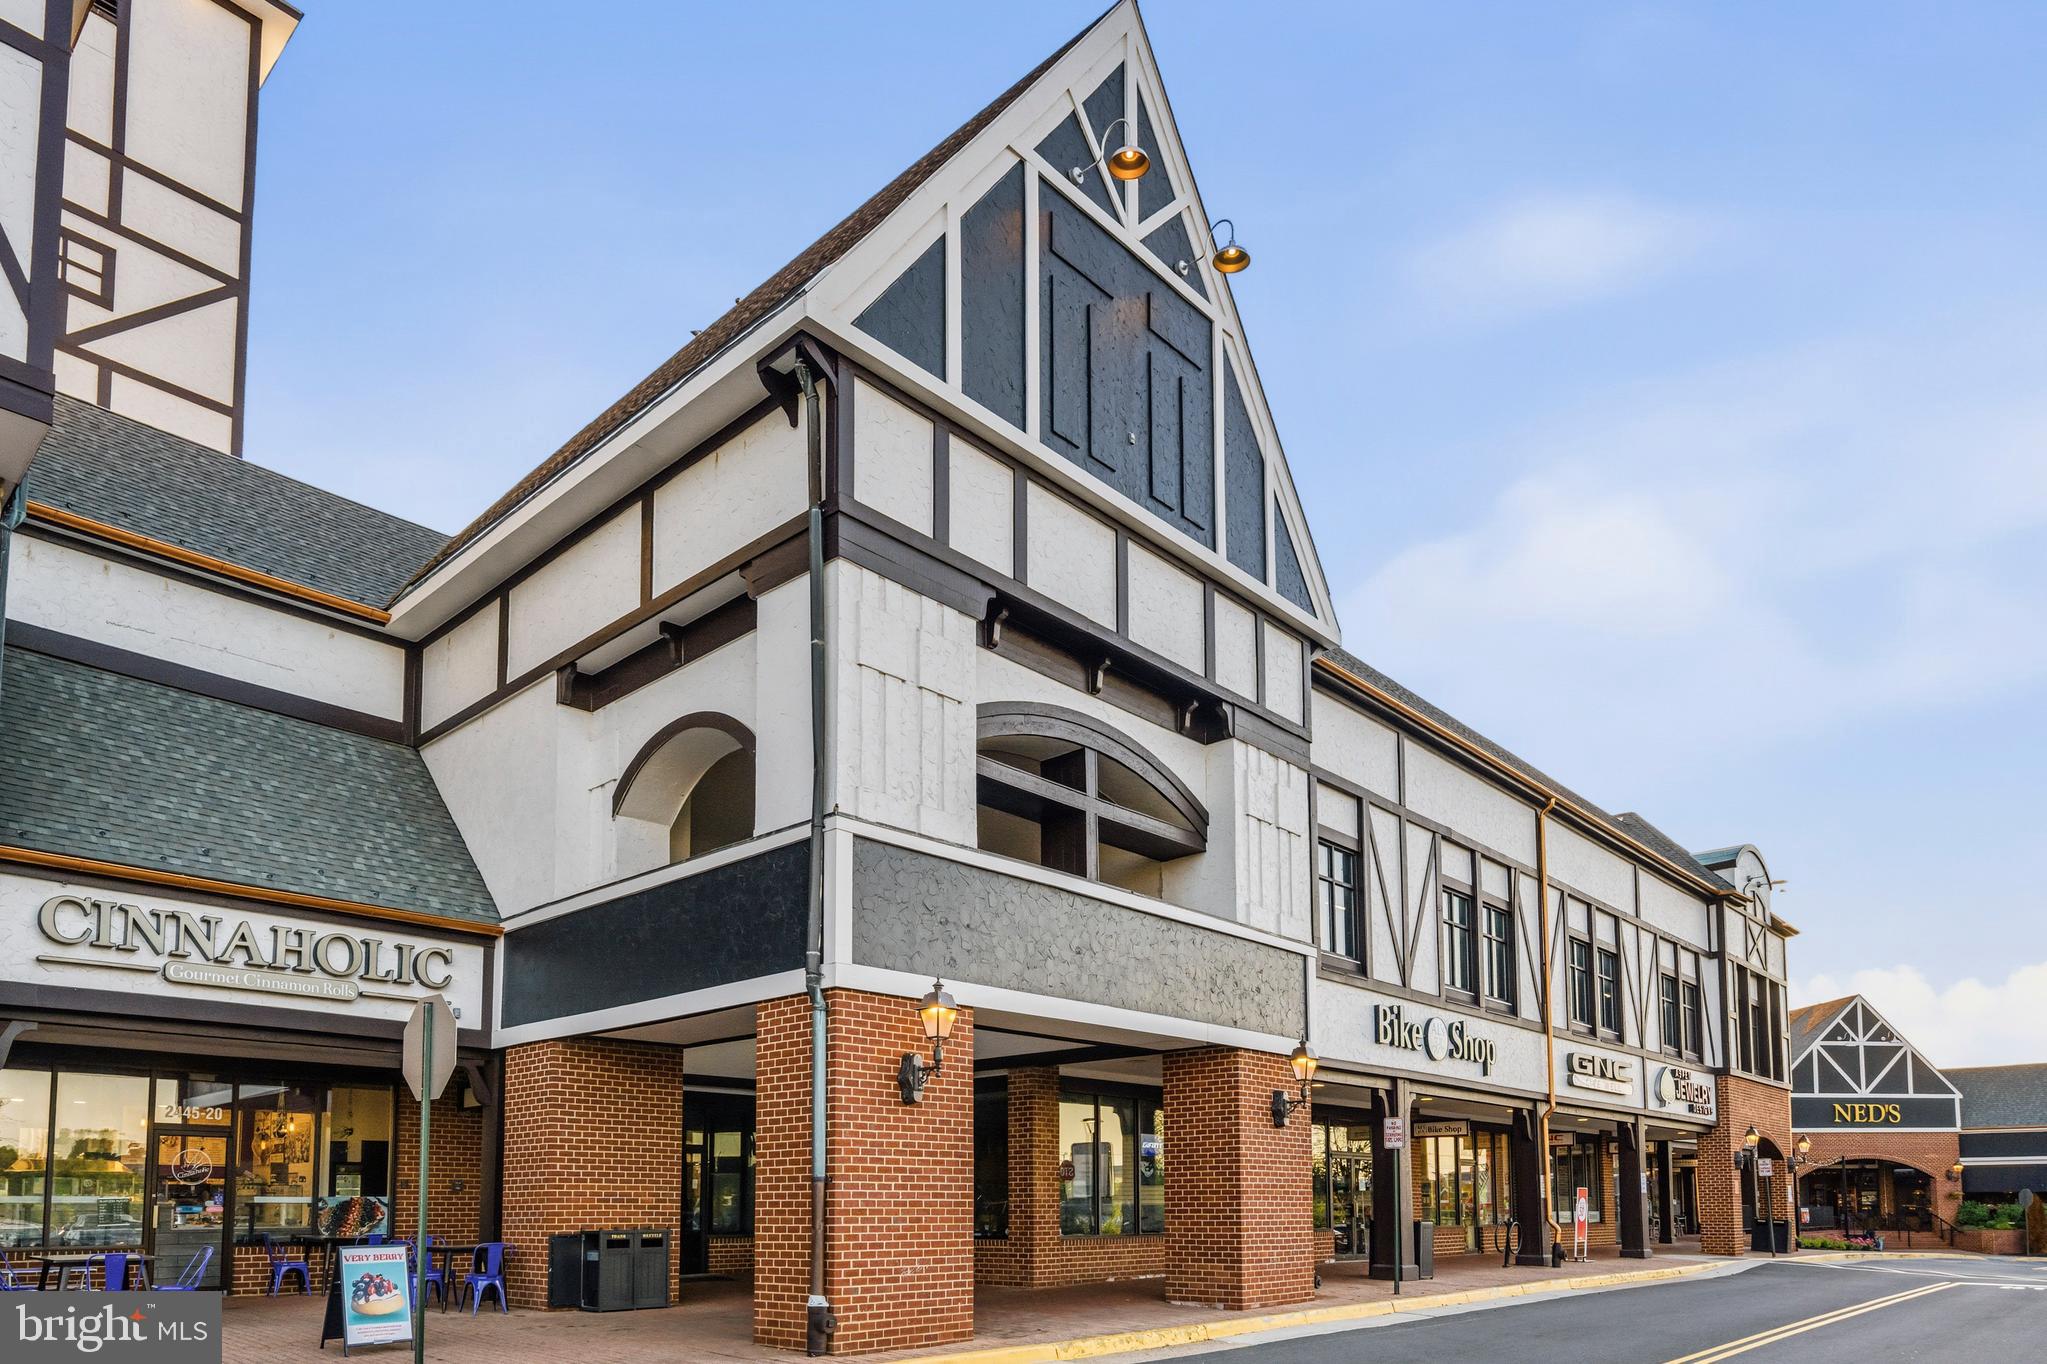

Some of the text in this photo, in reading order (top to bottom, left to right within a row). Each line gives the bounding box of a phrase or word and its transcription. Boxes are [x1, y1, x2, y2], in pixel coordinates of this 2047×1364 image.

[38, 895, 453, 989] CINNAHOLIC
[169, 964, 355, 998] Gourmet Cinnamon Rolls
[1374, 1004, 1424, 1051] Bike
[1448, 1020, 1496, 1077] Shop
[1567, 1053, 1632, 1082] GNC
[1675, 1080, 1711, 1105] JEWELRY
[165, 1105, 222, 1120] 2445-20
[1832, 1103, 1901, 1123] NED'S
[1444, 1125, 1462, 1133] Shop
[344, 1253, 404, 1262] VERY BERRY
